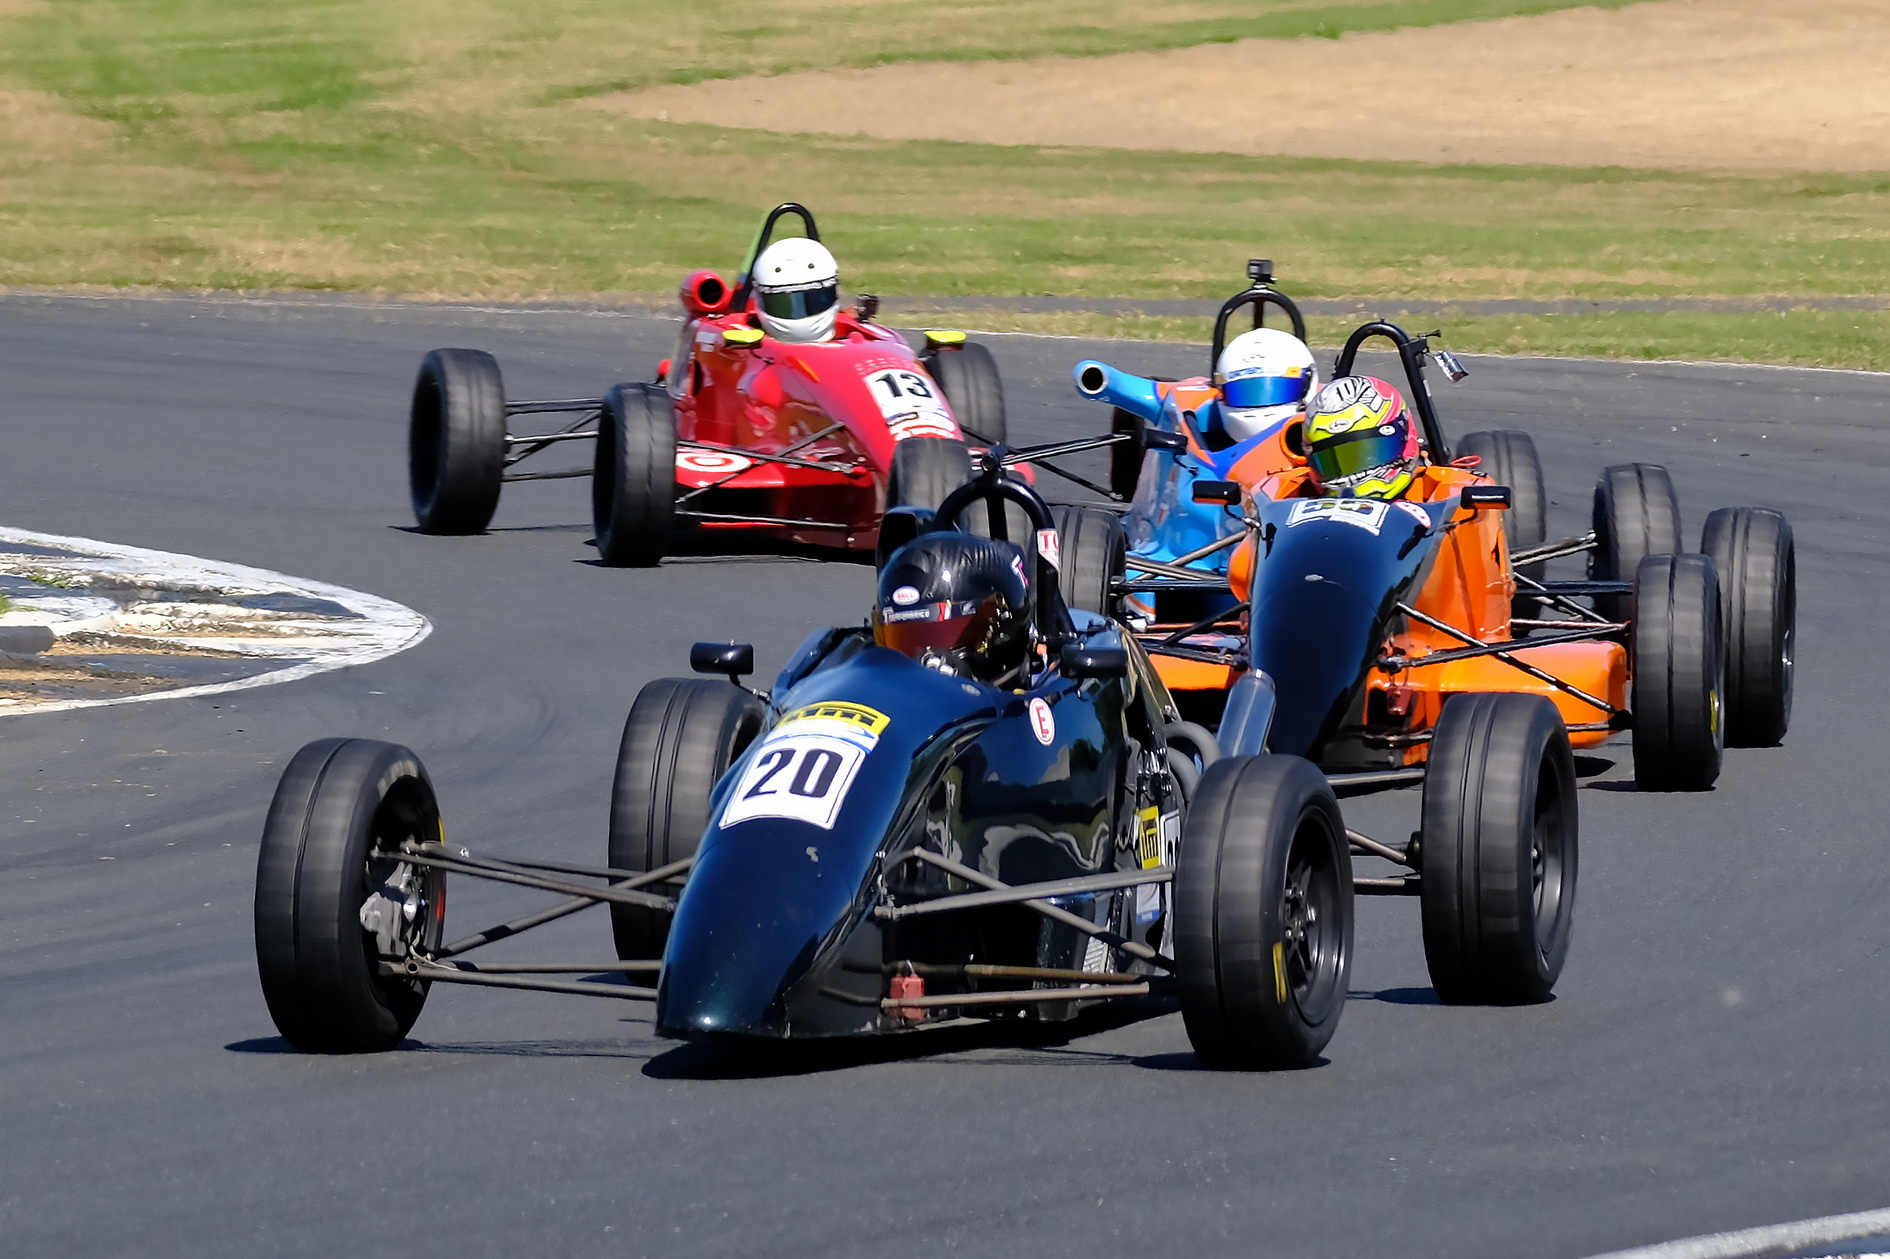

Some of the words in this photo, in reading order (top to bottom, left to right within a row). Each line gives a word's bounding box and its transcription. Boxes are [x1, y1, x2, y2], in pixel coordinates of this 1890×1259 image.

[875, 373, 933, 398] 13
[1036, 706, 1049, 735] E
[742, 748, 844, 802] 20
